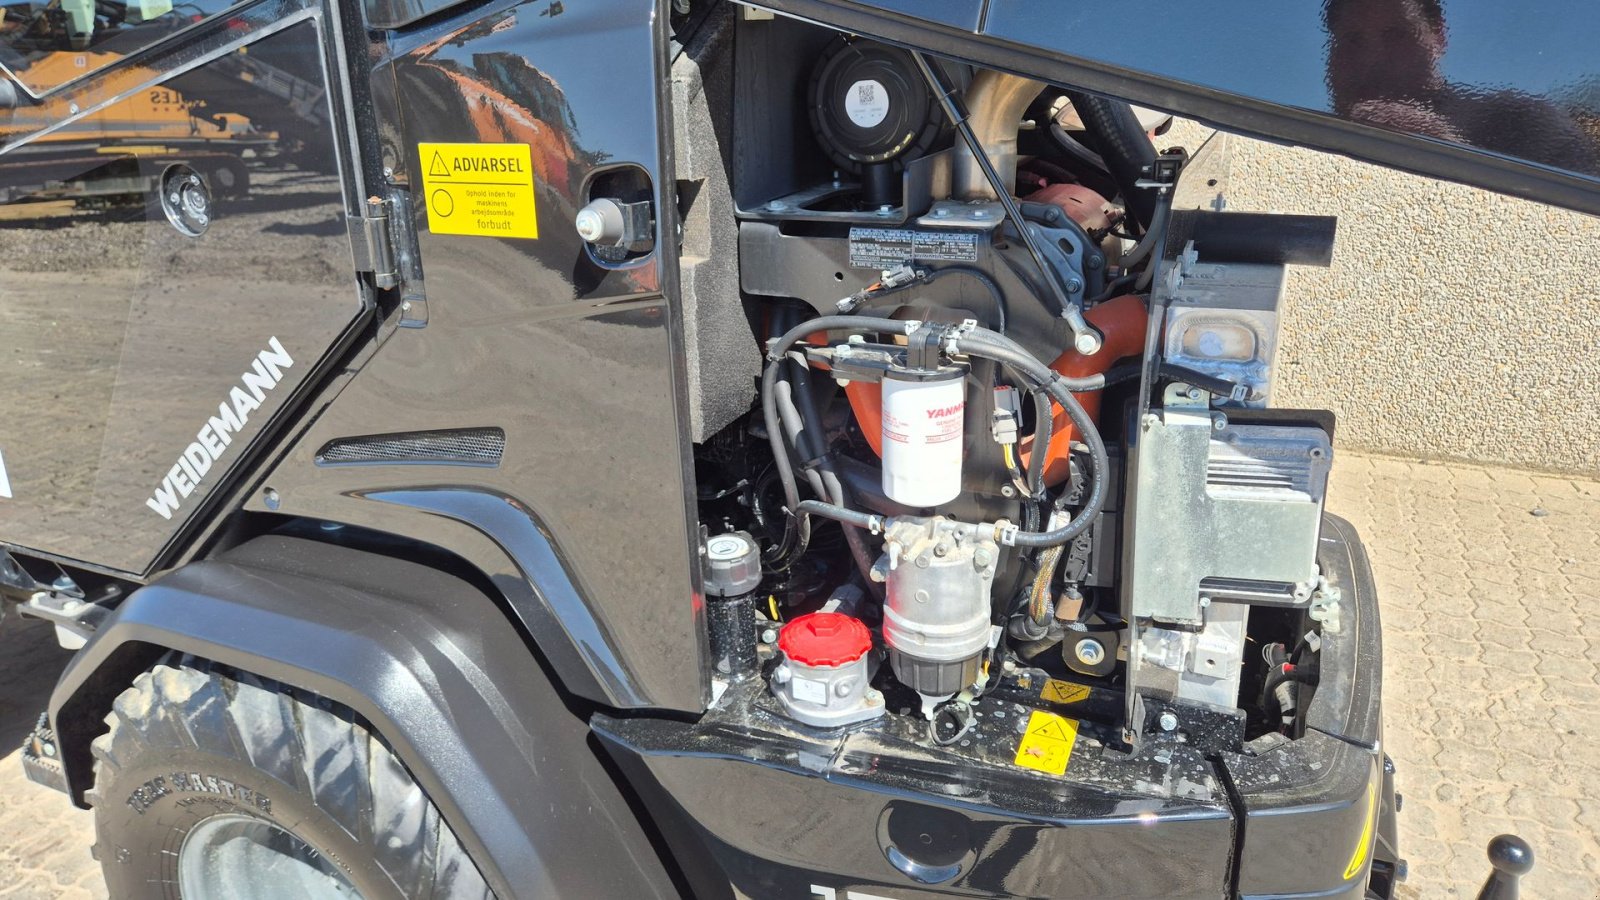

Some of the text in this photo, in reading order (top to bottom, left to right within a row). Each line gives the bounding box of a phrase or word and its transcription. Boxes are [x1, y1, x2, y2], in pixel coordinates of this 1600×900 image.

[453, 157, 524, 173] ADVARSEL
[465, 190, 487, 198] Ophold
[488, 190, 506, 198] inden
[476, 218, 512, 230] forbudt
[145, 335, 295, 521] WEIDEMANN
[170, 772, 274, 817] MASTER
